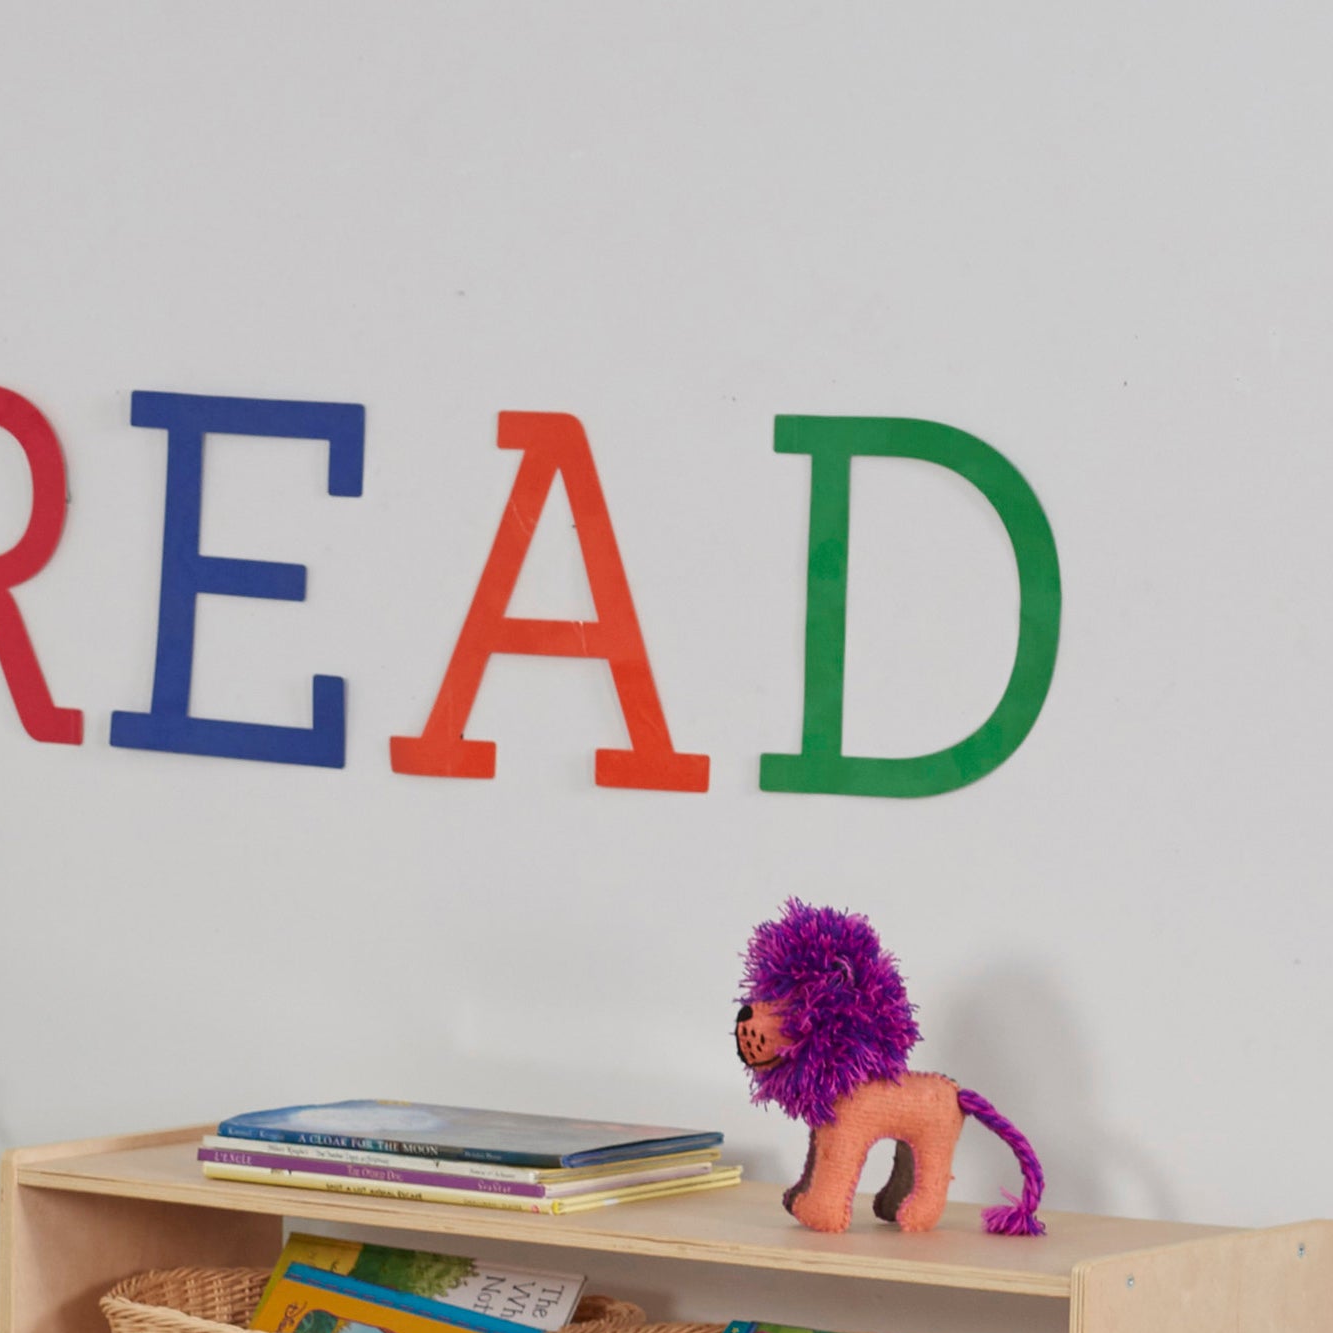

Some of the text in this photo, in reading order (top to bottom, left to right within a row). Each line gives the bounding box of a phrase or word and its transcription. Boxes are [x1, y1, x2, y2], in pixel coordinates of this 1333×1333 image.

[308, 1134, 348, 1147] CLOAK
[350, 1138, 375, 1149] FOR
[376, 1140, 400, 1151] THE
[401, 1142, 439, 1156] MOON
[531, 1284, 565, 1319] The
